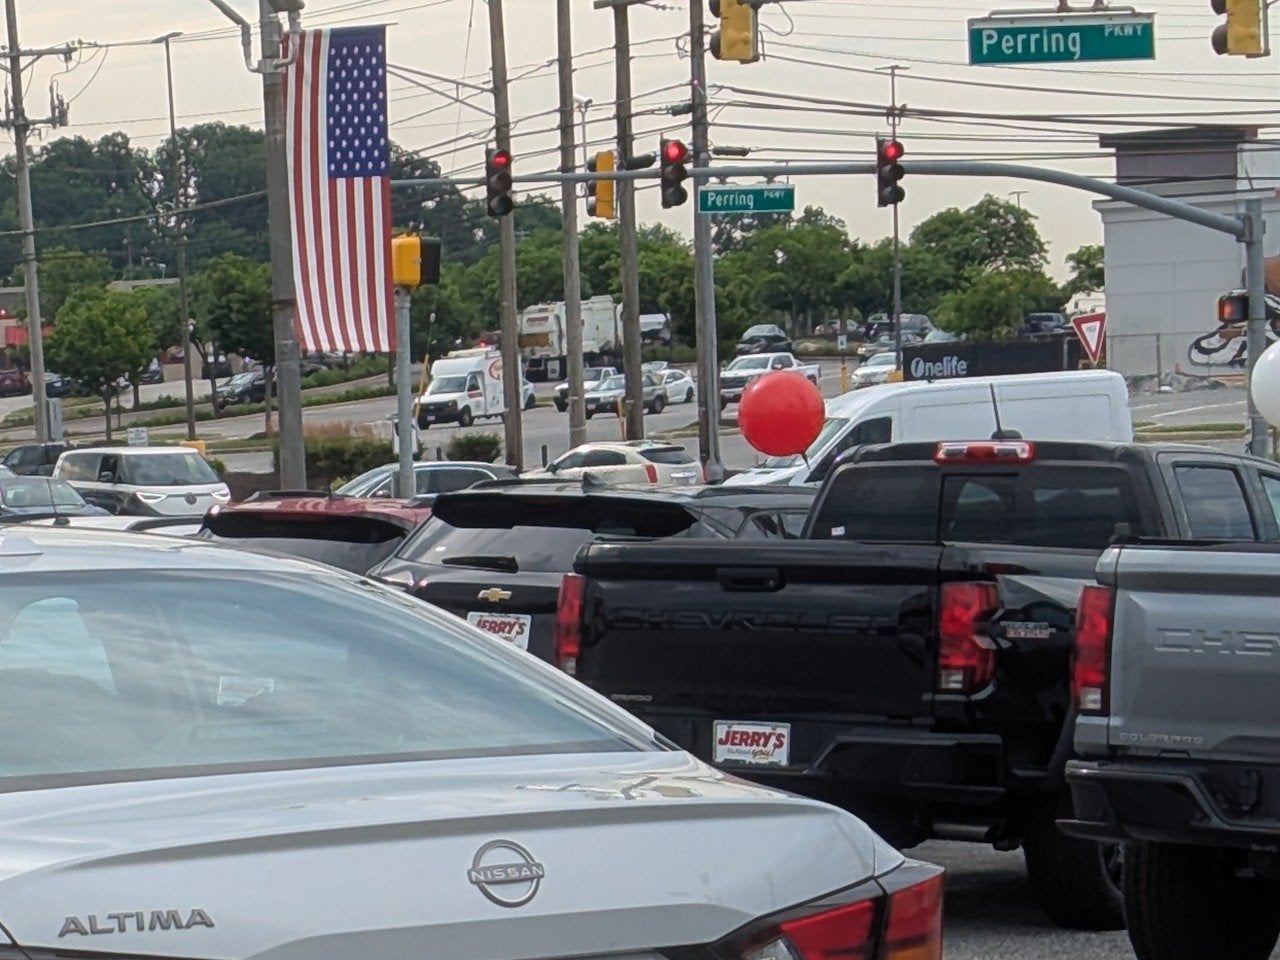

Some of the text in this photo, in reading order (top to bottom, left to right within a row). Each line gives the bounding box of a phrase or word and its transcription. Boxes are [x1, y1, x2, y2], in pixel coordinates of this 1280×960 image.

[982, 24, 1144, 60] Perring PKWY
[707, 191, 754, 209] Perring
[910, 354, 968, 378] Onelife
[718, 729, 786, 750] JERRY'S
[470, 865, 544, 881] NISSAN
[57, 908, 215, 938] ALTIMA
